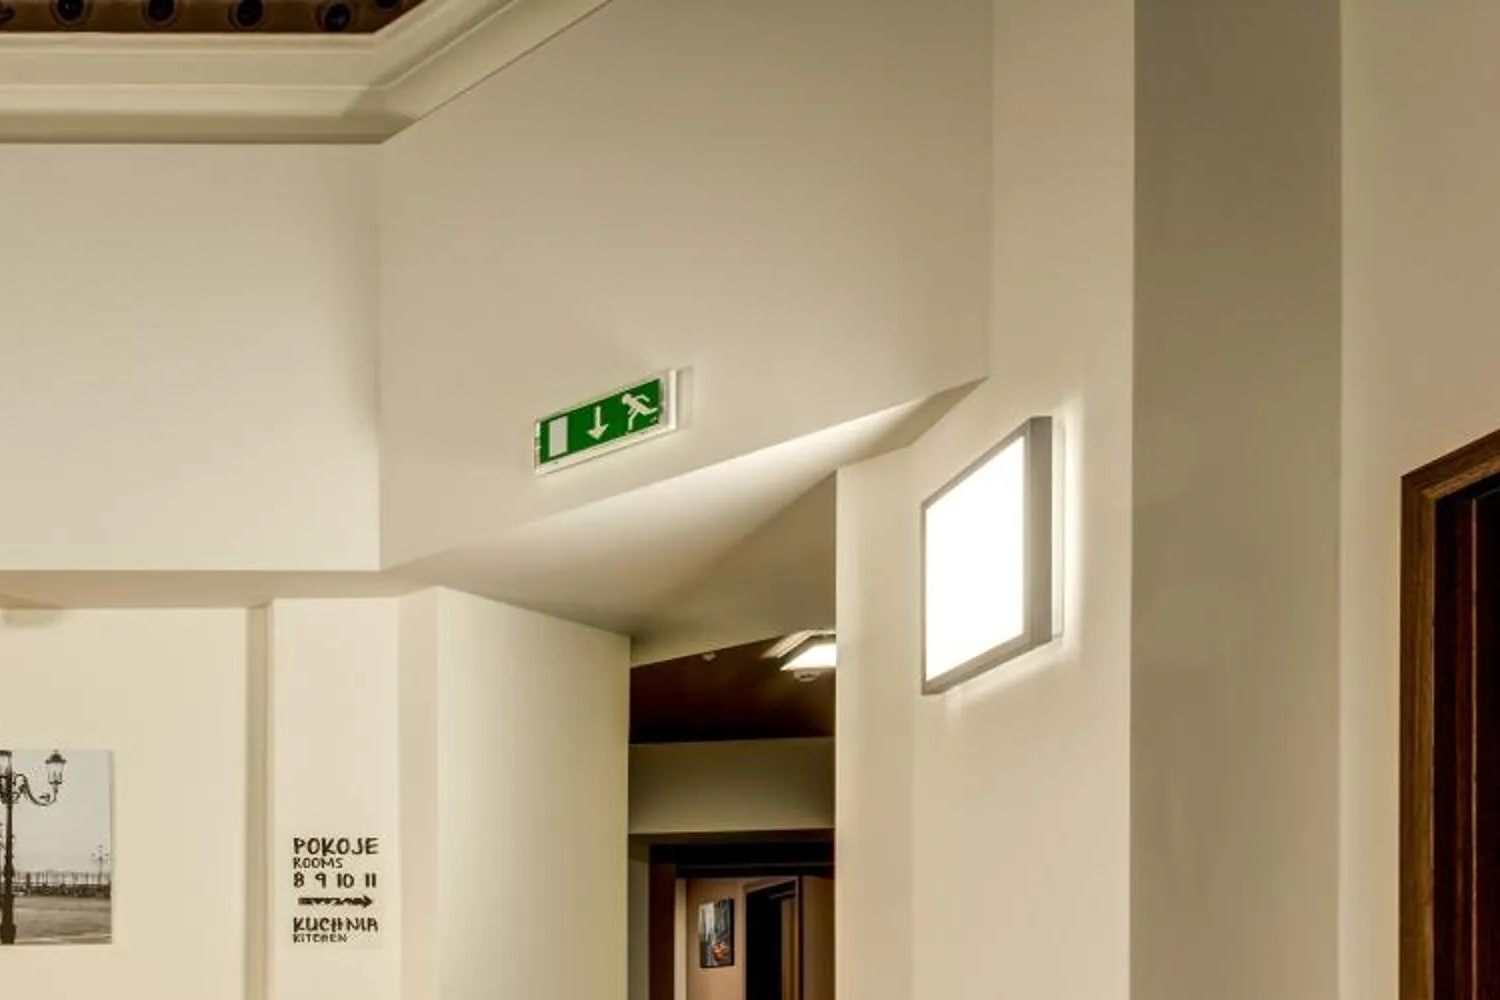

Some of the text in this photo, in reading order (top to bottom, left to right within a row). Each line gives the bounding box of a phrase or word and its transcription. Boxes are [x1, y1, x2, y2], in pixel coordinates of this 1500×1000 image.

[293, 837, 380, 857] POKOJE
[293, 857, 344, 869] ROOMS
[293, 871, 377, 889] 8 9 10 11
[293, 917, 379, 933] KUCHNIA
